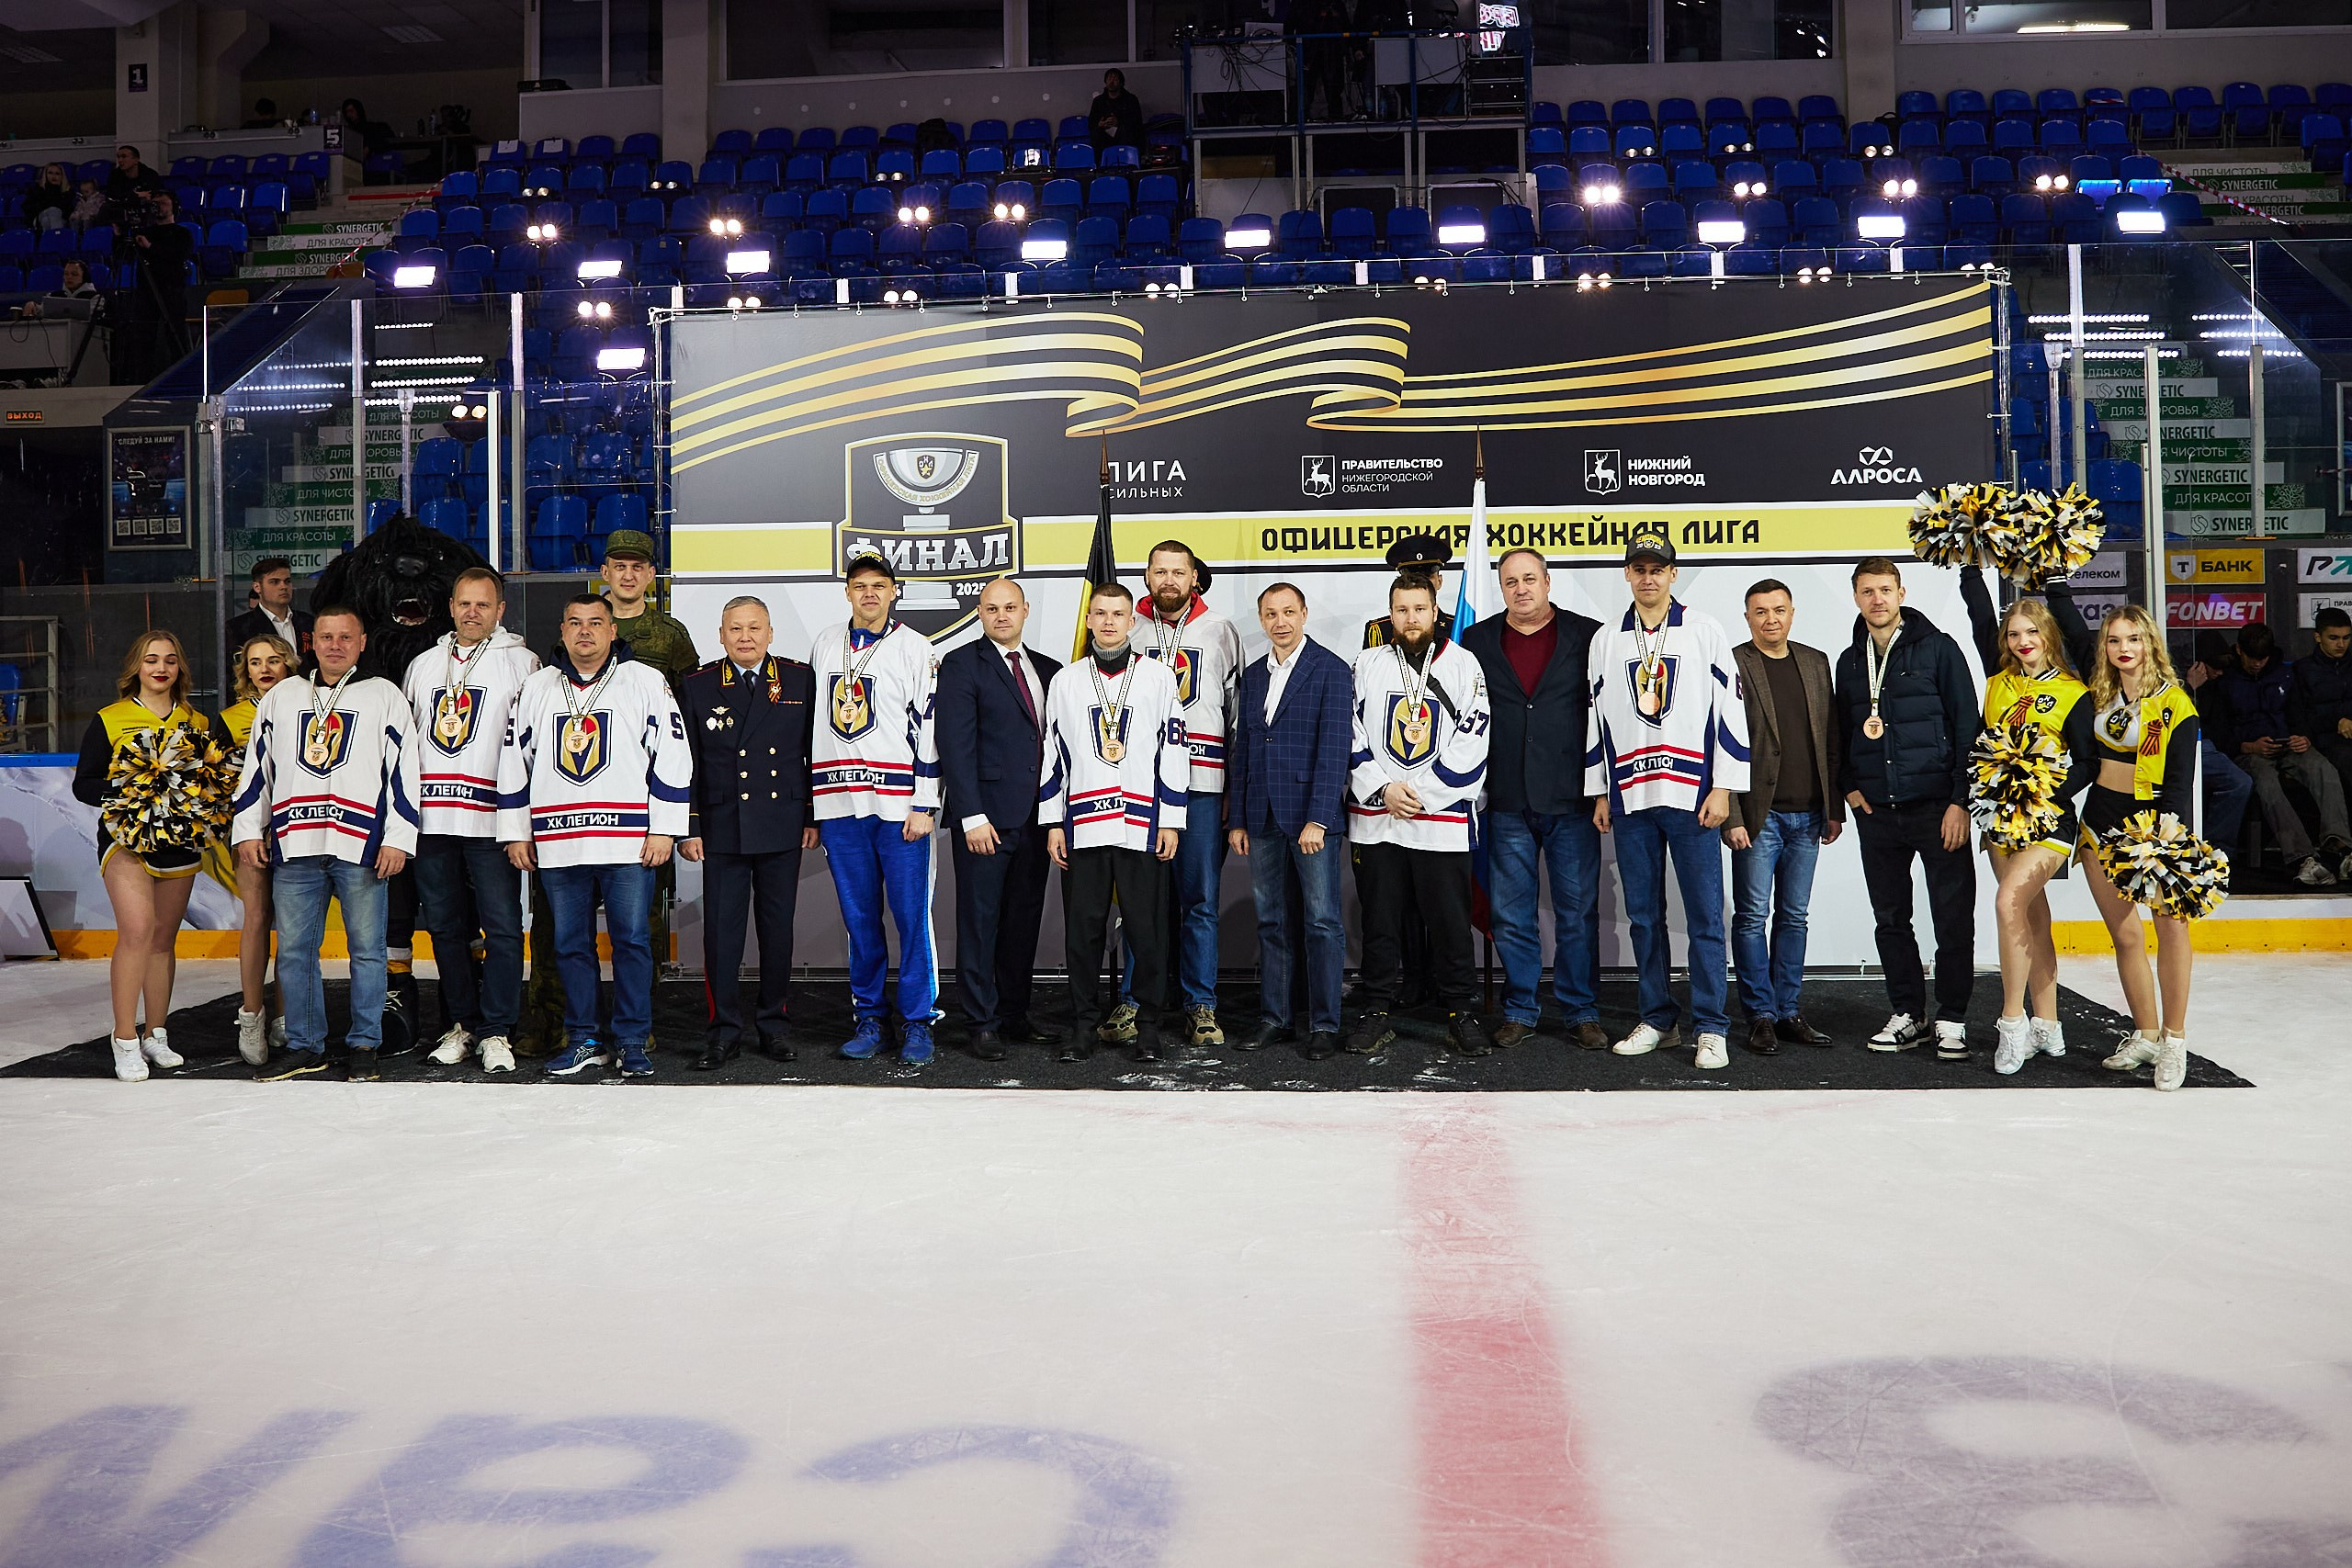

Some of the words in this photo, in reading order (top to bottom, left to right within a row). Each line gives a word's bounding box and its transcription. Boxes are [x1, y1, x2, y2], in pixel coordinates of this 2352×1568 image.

[132, 68, 144, 84] 1
[326, 129, 340, 145] 5
[2222, 179, 2278, 191] SYNERGETIC
[336, 222, 385, 233] SYNERGETIC
[307, 239, 326, 248] ДЛЯ
[277, 266, 297, 276] ДЛЯ
[2087, 368, 2110, 378] ДЛЯ
[2116, 384, 2185, 398] SYNEETIC
[390, 410, 439, 421] КРСОТЫ
[2110, 406, 2134, 417] ДЛЯ
[119, 436, 143, 446] СЛЕДУЙ
[154, 435, 175, 444] НАМИ!
[365, 428, 424, 441] SYNERGTIC
[329, 448, 351, 459] ДЛЯ
[2171, 446, 2227, 457] ЧИСТОТЫ
[1341, 458, 1443, 470] ПРАВИТЕЛЬСТВО
[1627, 456, 1691, 470] НИЖНИЙ
[1341, 471, 1433, 483] НИЖЕГОРОДСКОЙ
[1628, 473, 1706, 487] НОВГОРОД
[1830, 467, 1924, 485] АЛРОСА
[2174, 469, 2248, 483] SYNERGETIC
[1341, 483, 1390, 493] ОБЛАСТИ
[297, 490, 319, 500] ДЛЯ
[2175, 493, 2200, 505] ДЛЯ
[2204, 492, 2252, 503] КРАСОТ
[293, 508, 355, 523] SYNERGETIC
[2211, 516, 2289, 531] SYNERETIC
[263, 533, 284, 543] ДЛЯ
[286, 532, 336, 542] КРАСОТЫ
[1682, 519, 1759, 544] ЛИГА
[846, 533, 1009, 571] ФИНАЛ
[2201, 560, 2253, 573] БАНК
[2166, 601, 2264, 621] FONBET
[827, 772, 839, 783] ХК
[1093, 800, 1113, 811] ХК
[547, 818, 563, 829] ХК
[565, 814, 619, 827] ЛЕГИОН
